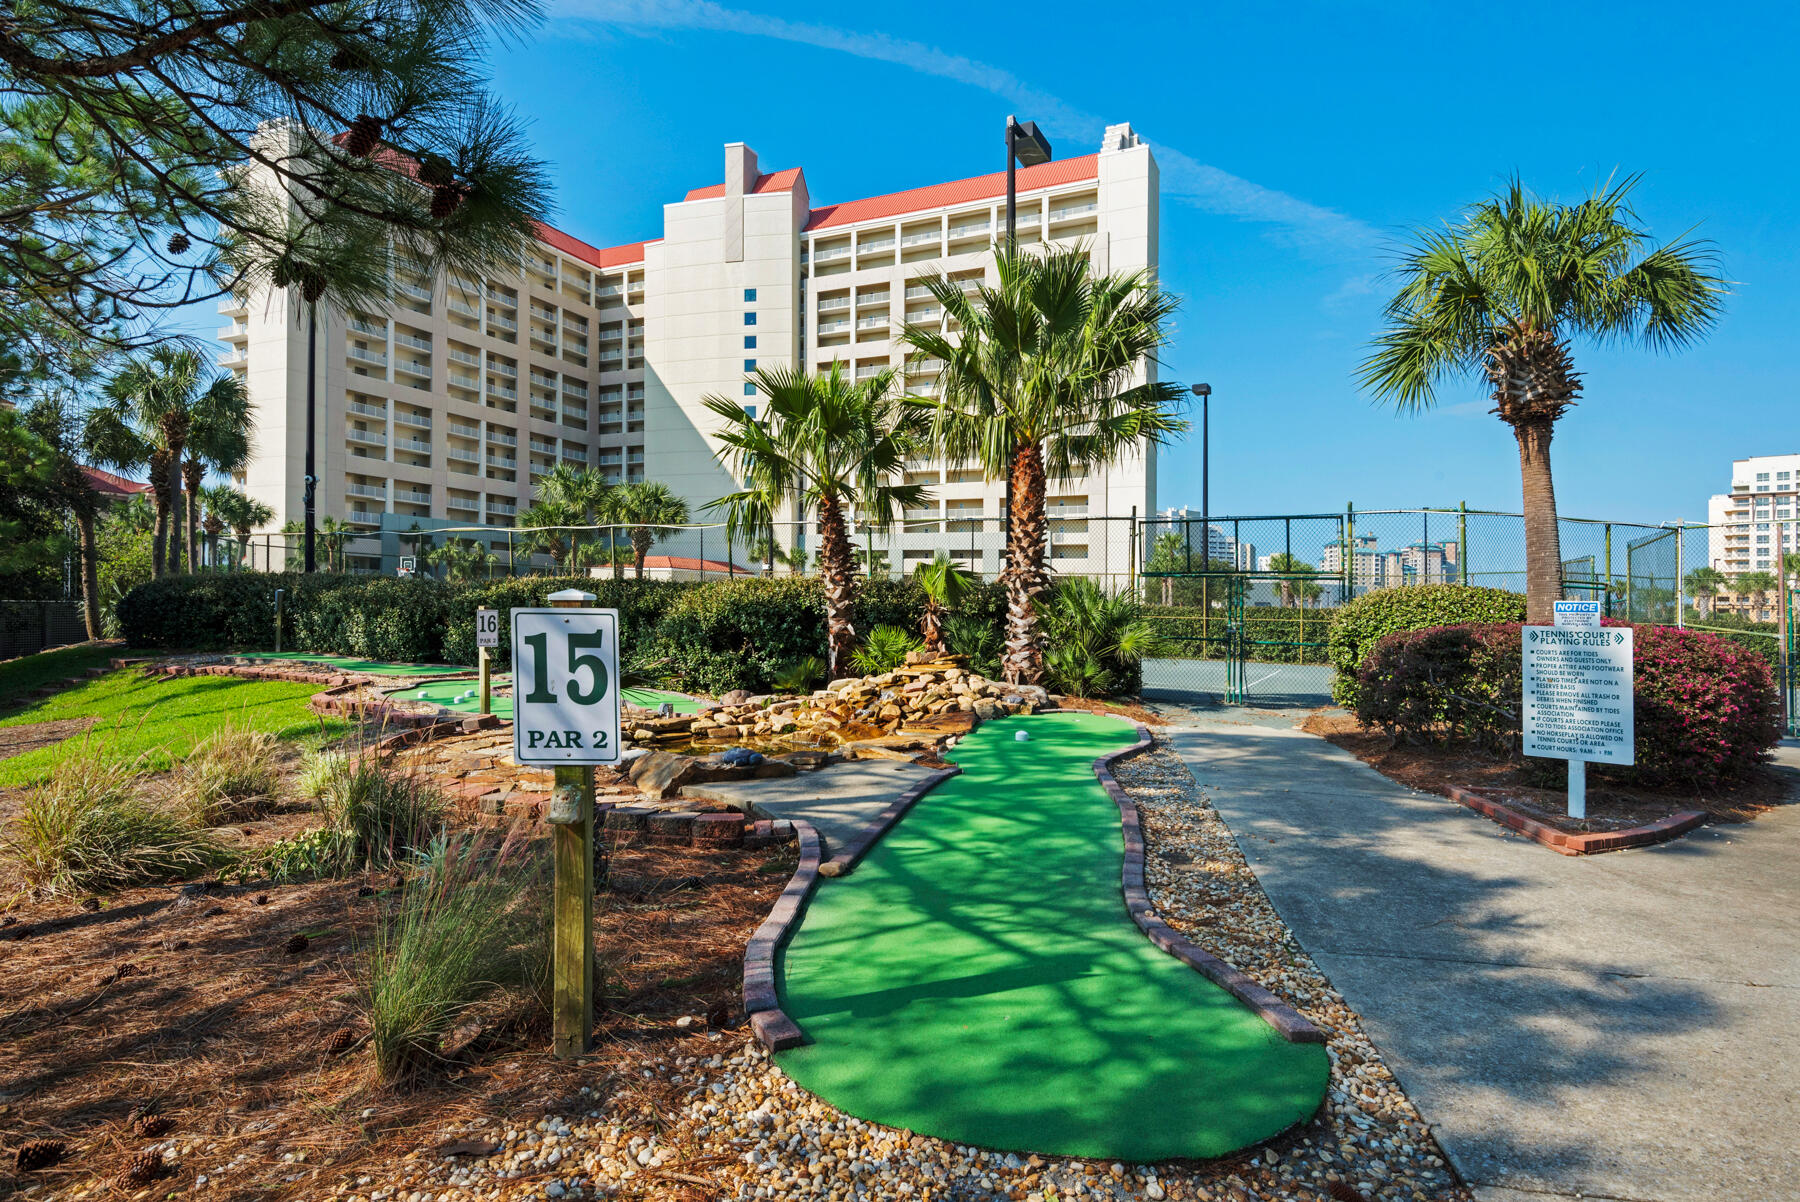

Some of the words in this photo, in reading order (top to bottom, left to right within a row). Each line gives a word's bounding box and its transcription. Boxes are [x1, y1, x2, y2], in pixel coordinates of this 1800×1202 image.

[1557, 604, 1596, 612] NOTICE
[479, 615, 496, 632] 16
[1540, 630, 1574, 638] TENNIS
[1540, 638, 1580, 646] PLAYING
[524, 629, 608, 706] 15
[528, 730, 584, 748] PAR
[592, 731, 608, 748] 2
